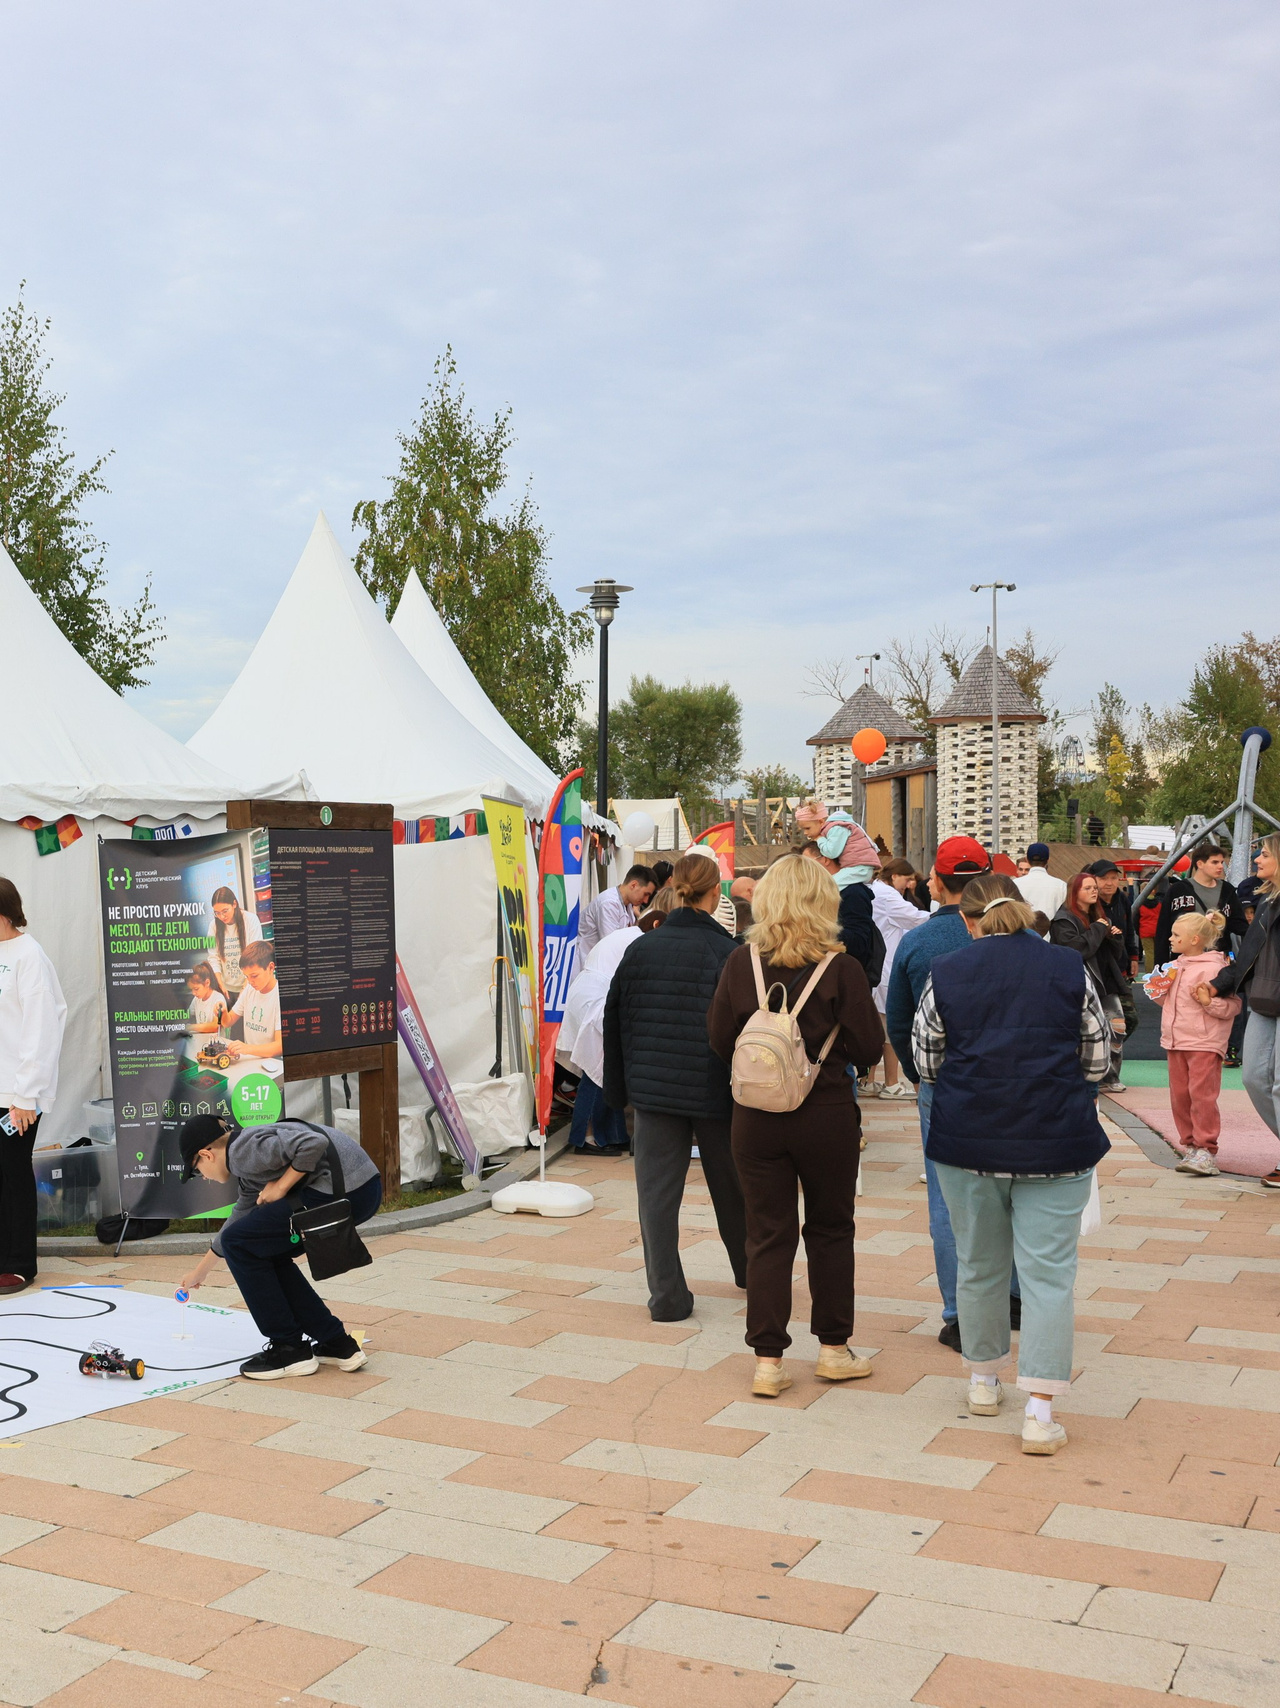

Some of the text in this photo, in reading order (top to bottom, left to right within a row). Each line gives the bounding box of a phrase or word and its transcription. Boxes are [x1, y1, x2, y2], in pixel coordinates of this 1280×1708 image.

[277, 846, 298, 854] ДЕТСКАЯ
[108, 902, 206, 920] НЕ ПРОСТО КРУЖОК
[110, 921, 190, 937] МЕСТО, ГДЕ ДЕТИ
[110, 936, 216, 954] СОЗДАЮТ ТЕХНОЛОГИИ
[114, 1009, 190, 1022] РЕАЛЬНЫЕ ПРОЕКТЫ
[242, 1085, 270, 1101] 5-17
